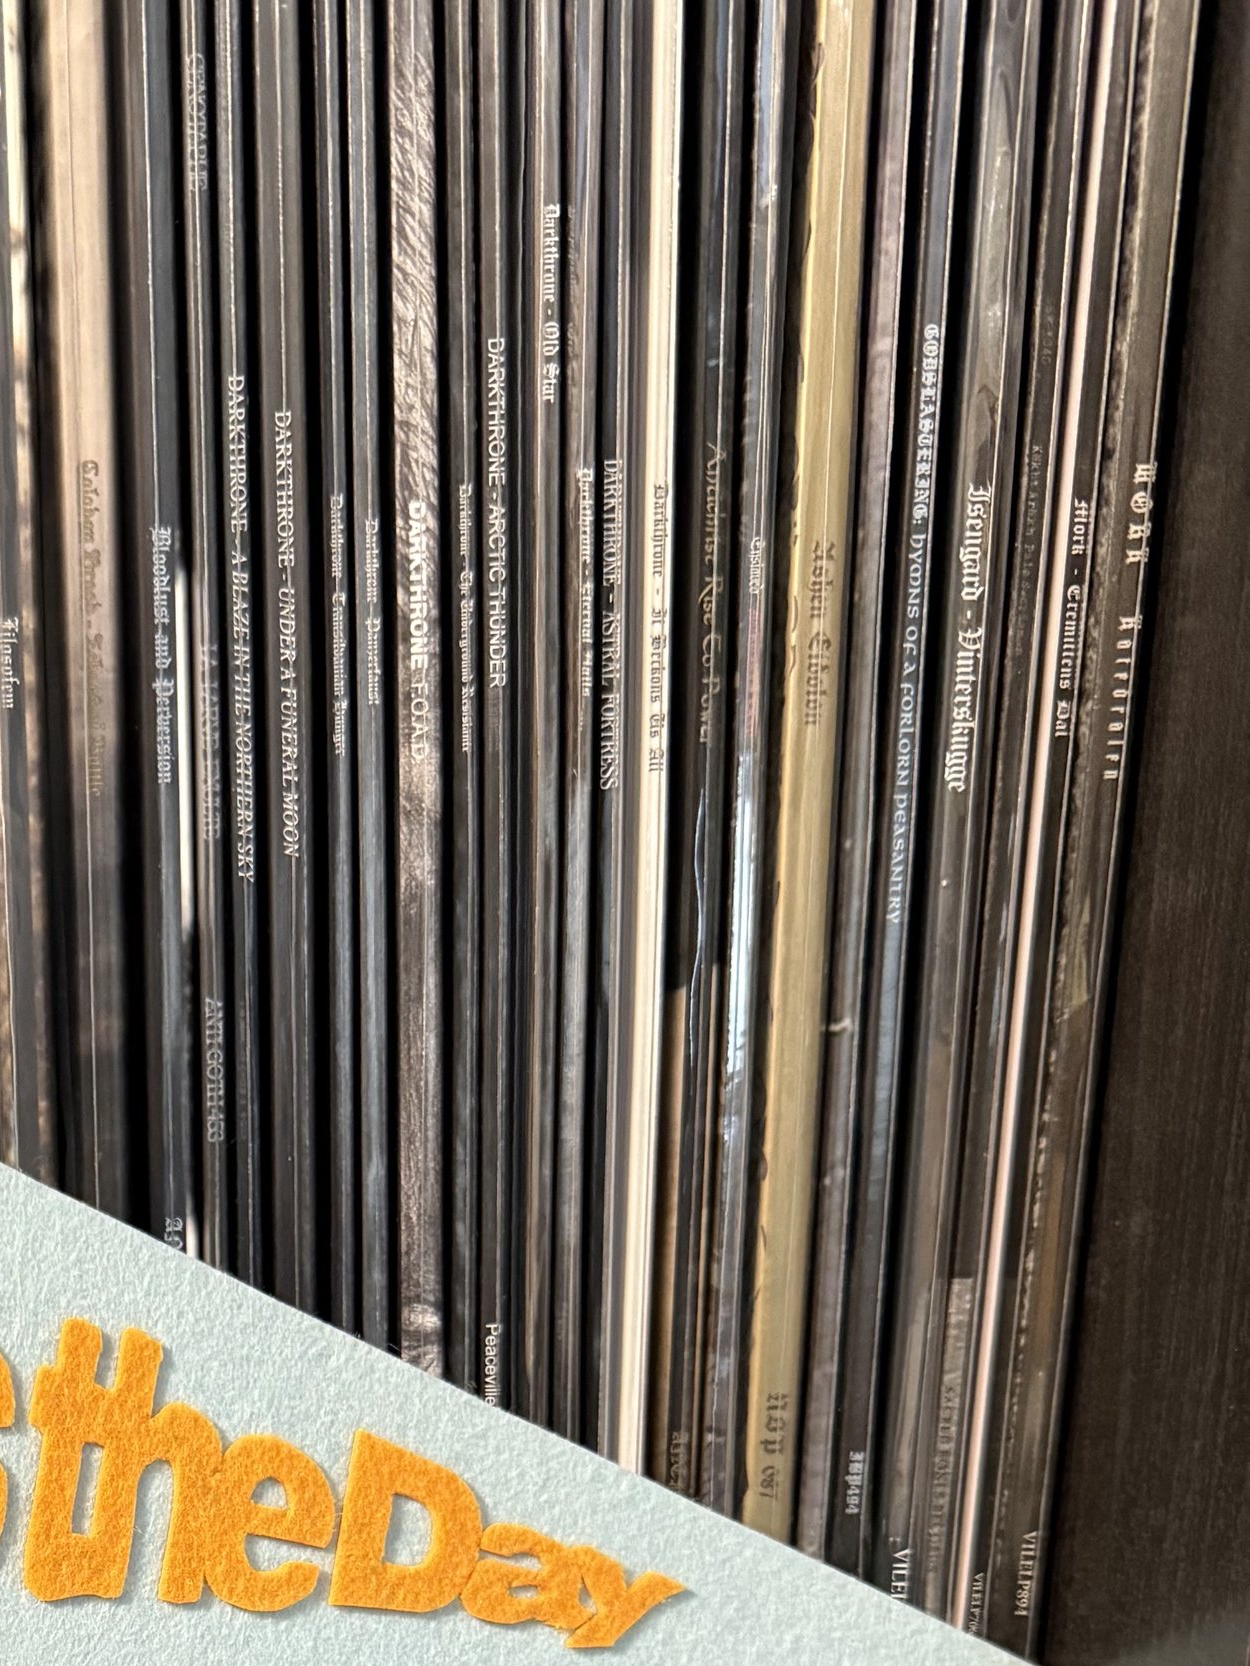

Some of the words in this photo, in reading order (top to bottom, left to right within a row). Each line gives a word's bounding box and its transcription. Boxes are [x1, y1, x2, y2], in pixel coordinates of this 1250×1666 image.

[541, 203, 561, 302] Darkthrone
[542, 321, 561, 356] Old
[486, 338, 506, 486] DARKTHRONE
[541, 362, 560, 403] Star
[911, 323, 940, 525] GODSLASTERING:
[227, 375, 249, 533] DARKTHRONE
[274, 410, 295, 568] DARKTHRONE
[329, 494, 345, 578] Darkthrone
[459, 482, 473, 556] Darkthrone
[487, 504, 507, 582] ARCTIC
[576, 467, 595, 564] Darkthrone
[600, 458, 625, 587] DARKTHRONE
[649, 482, 670, 578] Darkthrone
[958, 481, 992, 601] Isengard
[151, 526, 173, 625] Bloodlust
[230, 550, 249, 566] A
[364, 518, 380, 603] Darkthrone
[408, 501, 430, 669] DARKTHRONE
[460, 570, 474, 596] The
[697, 575, 725, 624] Rise
[807, 540, 836, 620] Ashen
[231, 569, 249, 641] BLAZE
[278, 586, 297, 663] UNDER
[488, 586, 507, 687] THUNDER
[0, 616, 21, 708] Filosofem
[155, 631, 173, 669] and
[232, 644, 249, 666] IN
[280, 665, 298, 682] A
[600, 610, 622, 686] ASTRAL
[153, 678, 176, 784] Perversion
[233, 671, 250, 717] THE
[697, 676, 721, 745] Power
[943, 625, 983, 794] Vinterskugge
[1053, 700, 1071, 738] Dal
[279, 686, 299, 789] FUNERAL
[598, 692, 621, 790] FORTRESS
[648, 748, 666, 773] All
[234, 722, 253, 838] NORTHERN
[236, 841, 255, 883] SKY
[282, 792, 300, 858] MOON
[484, 1323, 501, 1407] Peaceville
[24, 1317, 339, 1613] the
[328, 1429, 688, 1649] Day
